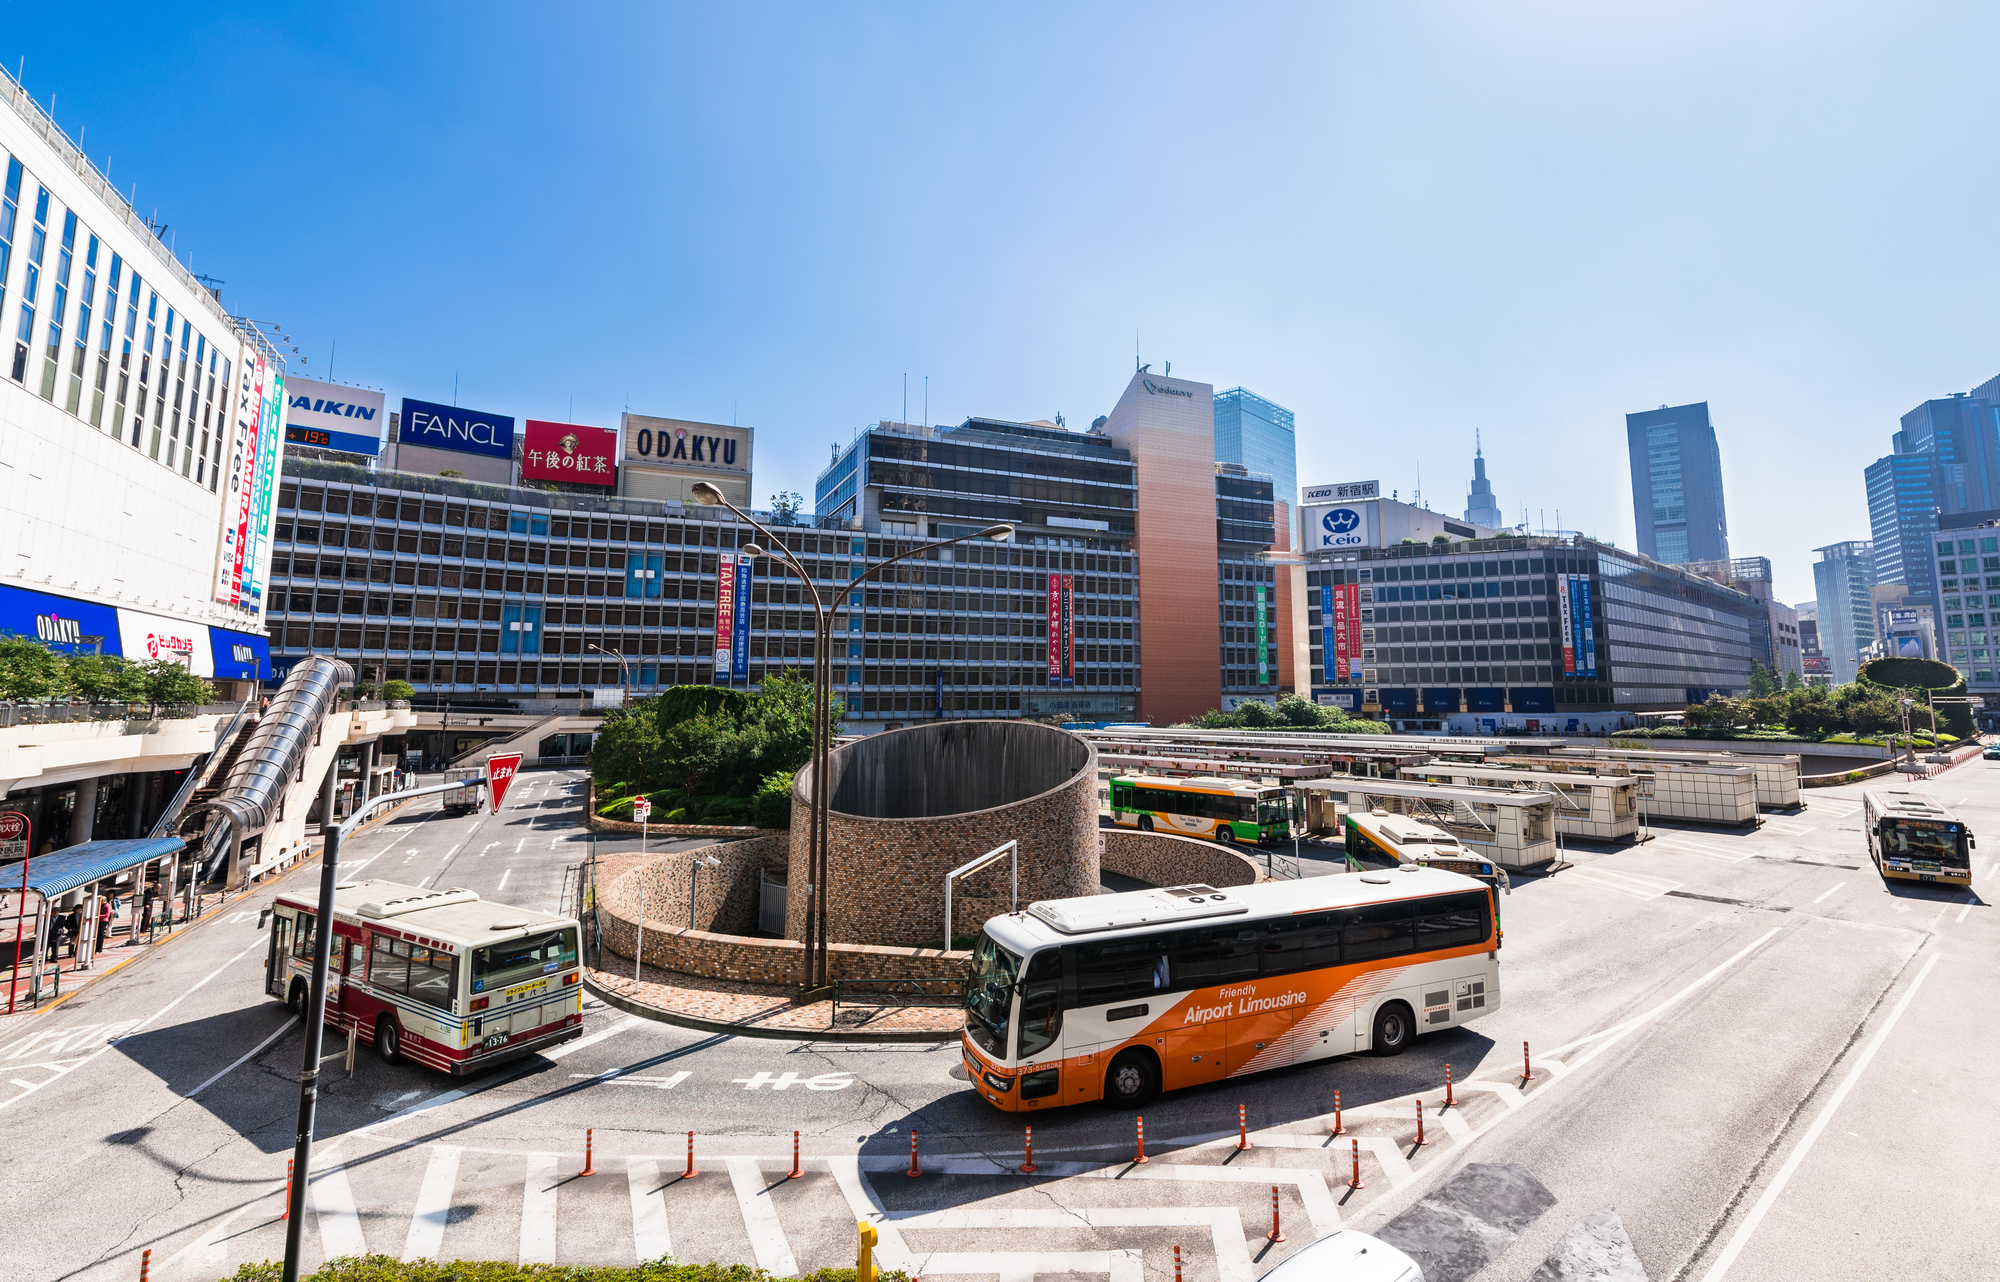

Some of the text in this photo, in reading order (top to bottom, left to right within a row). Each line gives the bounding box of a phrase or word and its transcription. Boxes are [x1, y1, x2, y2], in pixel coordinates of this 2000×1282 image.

[251, 391, 261, 428] BIC
[231, 358, 255, 493] Tax Free
[411, 411, 504, 447] FANCL
[527, 449, 608, 474] 午後の紅茶
[637, 428, 737, 465] ODAKYU
[239, 432, 255, 525] CAMERA
[1307, 483, 1374, 499] KEIO 新宿駅
[1323, 533, 1361, 546] Keio
[719, 566, 732, 617] TAX FREE
[36, 613, 80, 644] ODAKYU
[1335, 590, 1347, 651] 質流れ品大市
[158, 634, 193, 651] ビックカメラ
[492, 765, 513, 780] 止まれ
[506, 986, 547, 1003] 関東バス
[1183, 990, 1307, 1024] Airport Limousine
[1219, 984, 1256, 999] Friendly
[488, 1035, 508, 1047] 13-76
